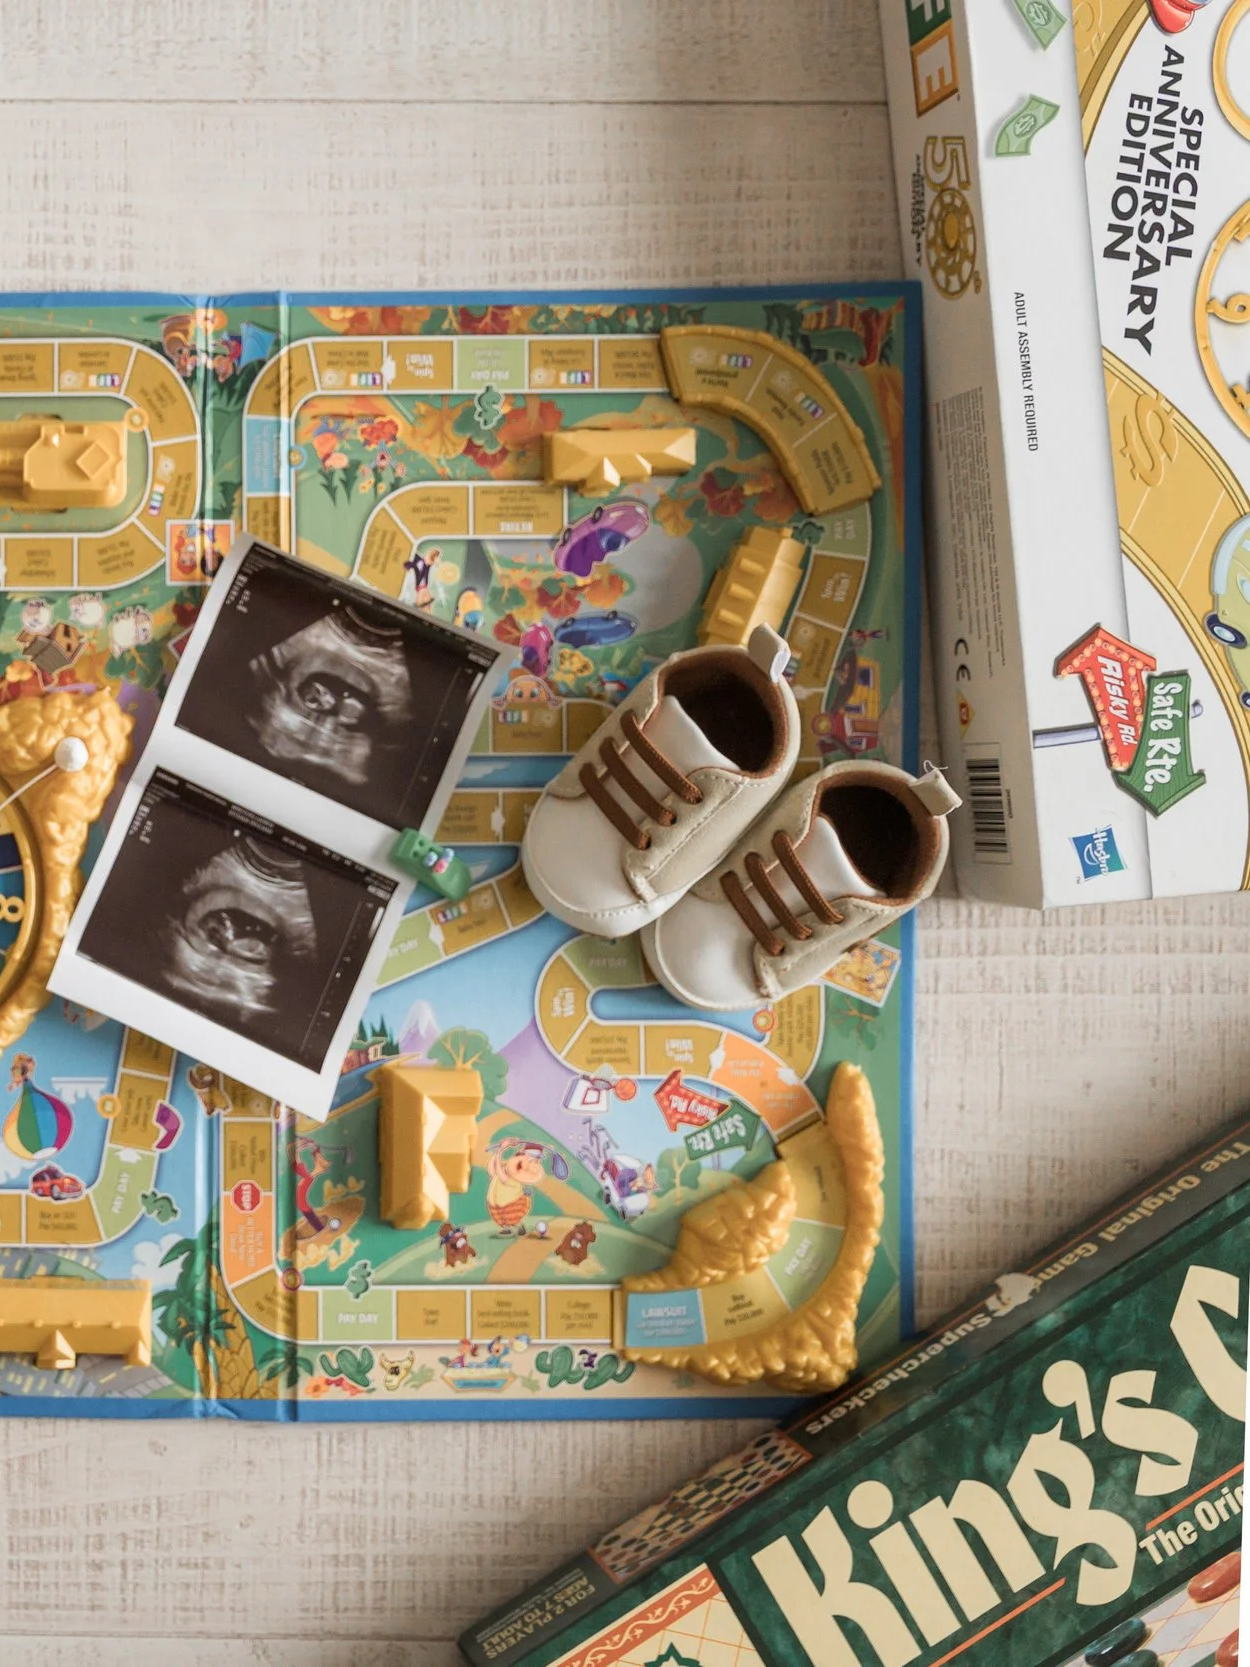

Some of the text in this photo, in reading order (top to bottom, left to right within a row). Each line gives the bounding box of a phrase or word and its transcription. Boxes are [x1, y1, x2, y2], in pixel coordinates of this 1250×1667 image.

[1103, 93, 1154, 261] EDITION
[1124, 44, 1185, 356] ANNIVERSARY
[1165, 105, 1204, 267] SPECIAL
[1013, 291, 1039, 452] ADULT ASSEMBLY REQUIRED
[1096, 655, 1138, 747] Risky Rd.
[1143, 681, 1184, 793] Safe Rte.
[713, 1113, 747, 1145] Safe
[1199, 1141, 1250, 1174] The
[1098, 1173, 1201, 1243] Original
[804, 1311, 993, 1438] Supercheckers
[751, 1359, 1200, 1667] King's
[1137, 1527, 1199, 1566] The
[485, 1583, 596, 1660] FOR 2 PLAYERS
[523, 1608, 544, 1621] TO
[552, 1575, 589, 1602] AGES
[481, 1618, 523, 1653] ADULT
